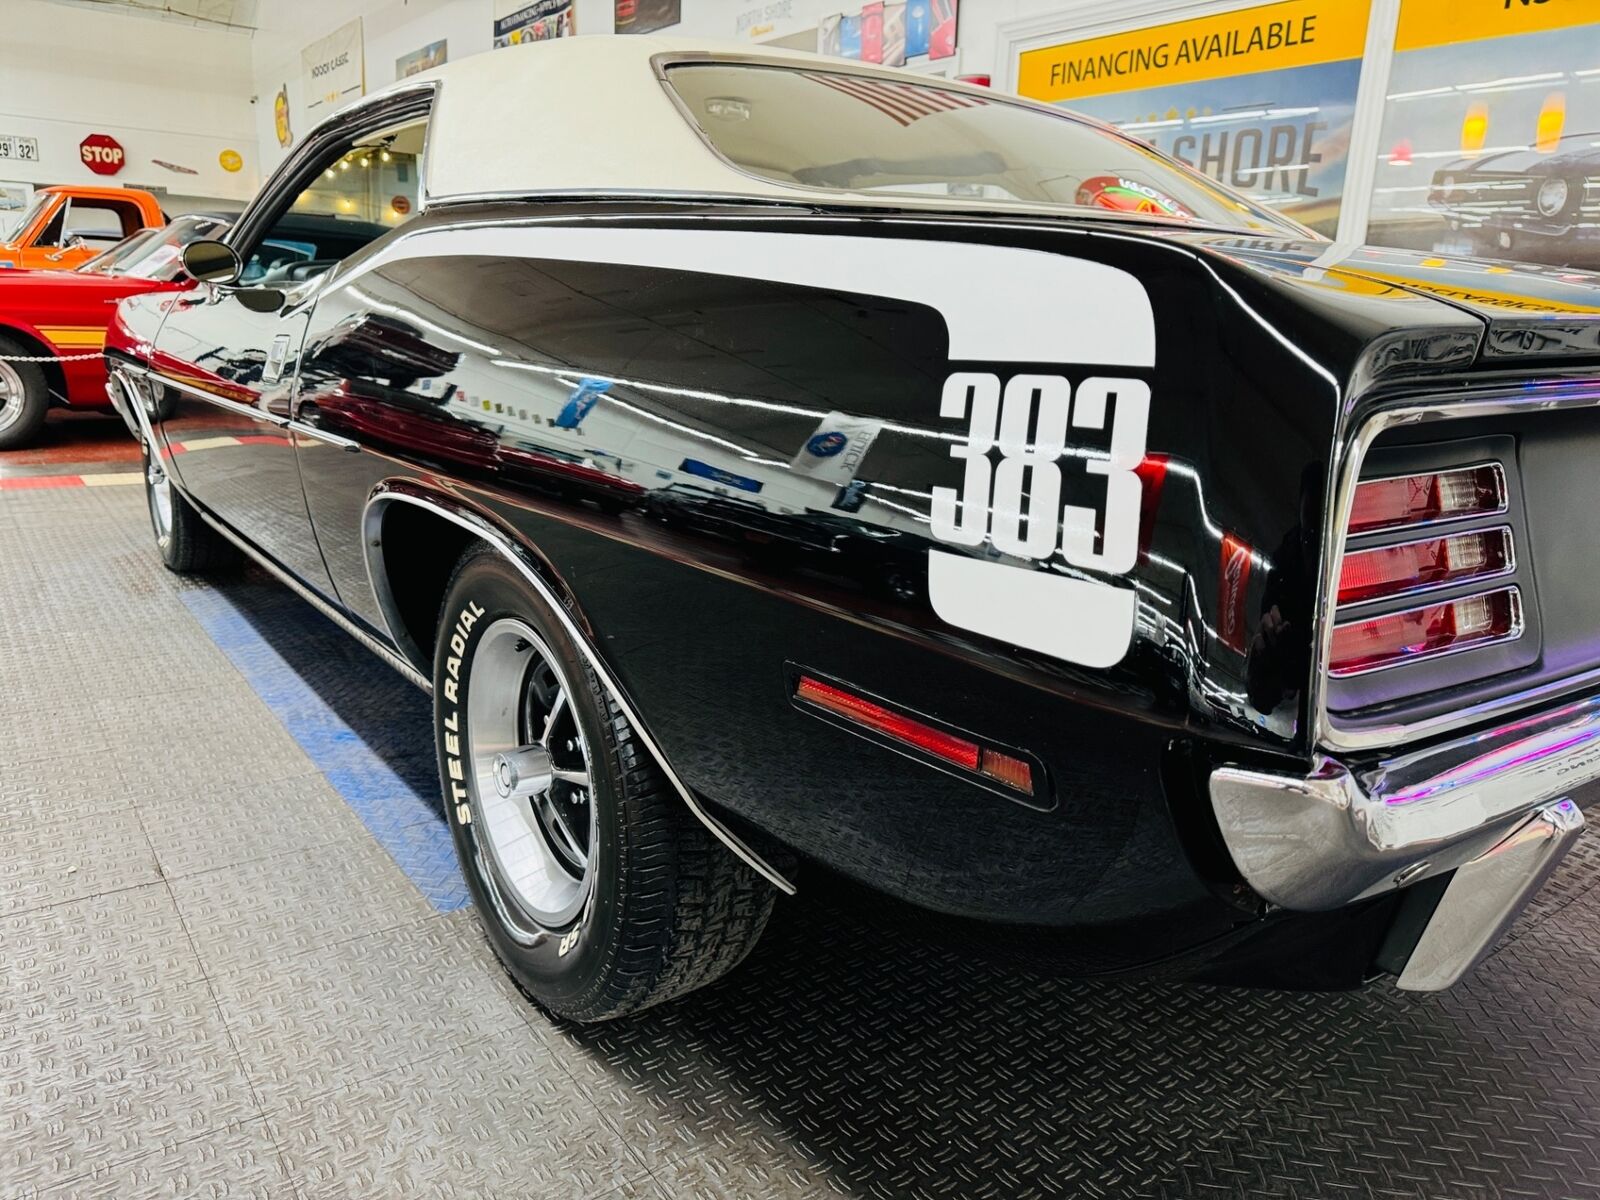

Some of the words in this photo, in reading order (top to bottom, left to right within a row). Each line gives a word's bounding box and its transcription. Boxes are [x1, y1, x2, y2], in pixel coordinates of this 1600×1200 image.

[1050, 43, 1169, 87] FINANCING
[1174, 15, 1317, 66] AVAILABLE
[82, 145, 123, 164] STOP
[1172, 120, 1328, 197] SHORE
[930, 371, 1151, 574] 383
[444, 600, 486, 704] RADIAL
[444, 710, 473, 826] STEEL
